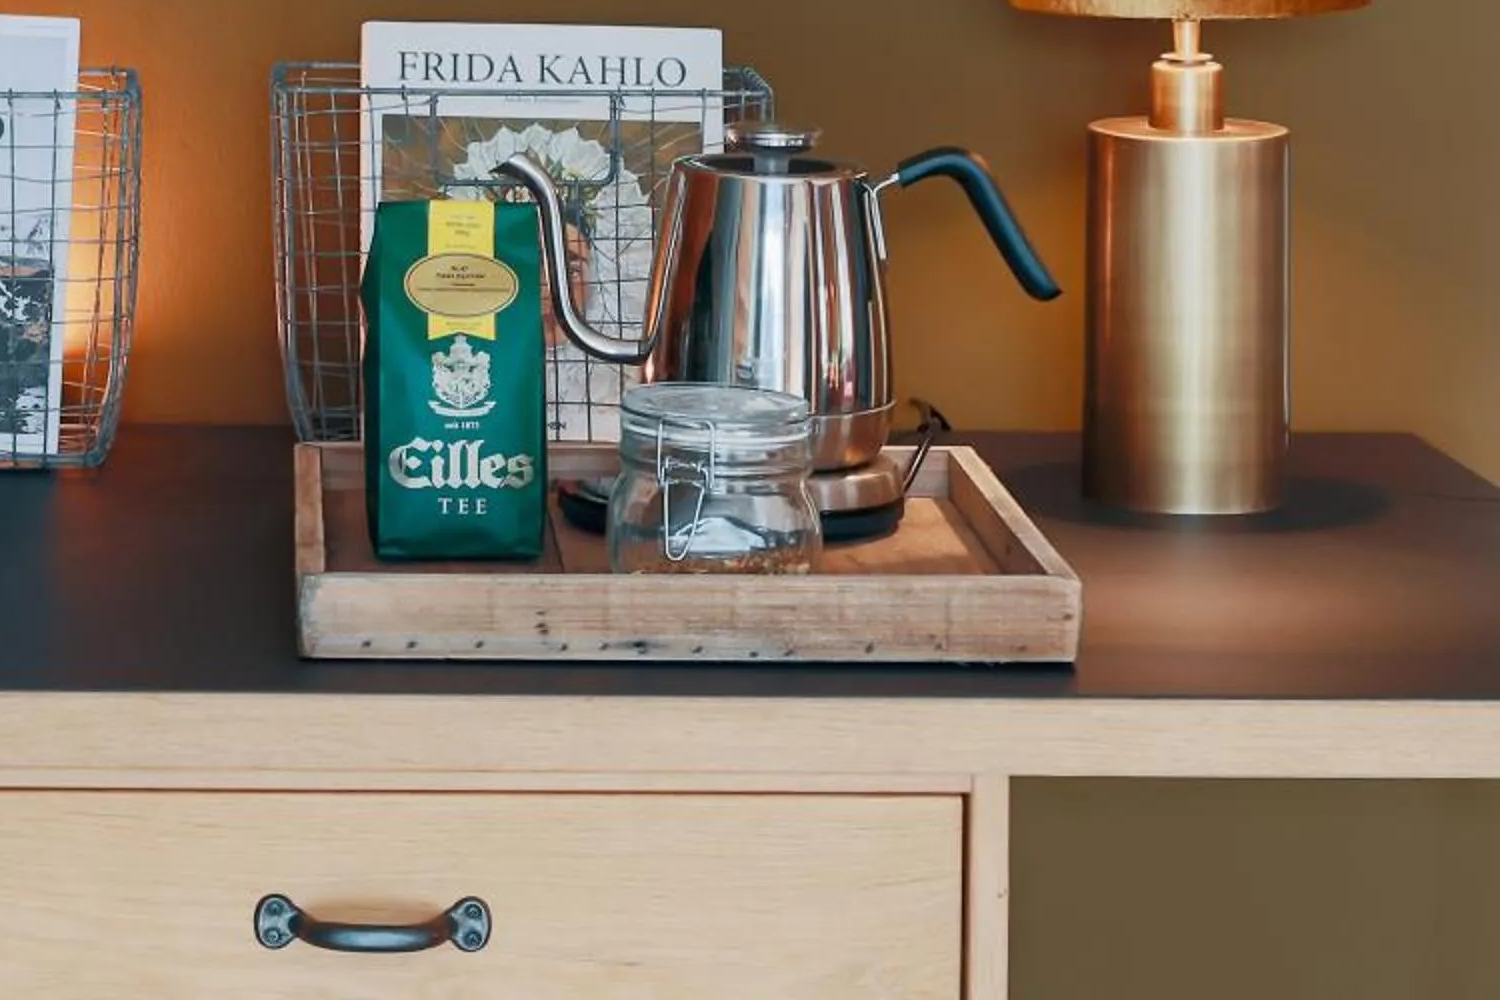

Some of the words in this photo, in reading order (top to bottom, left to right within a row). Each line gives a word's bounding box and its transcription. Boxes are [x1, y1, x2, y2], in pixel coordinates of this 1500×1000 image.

[398, 51, 523, 83] FRIDA
[538, 54, 687, 88] KAHLO
[388, 437, 535, 490] Eilles
[437, 497, 488, 516] TEE
